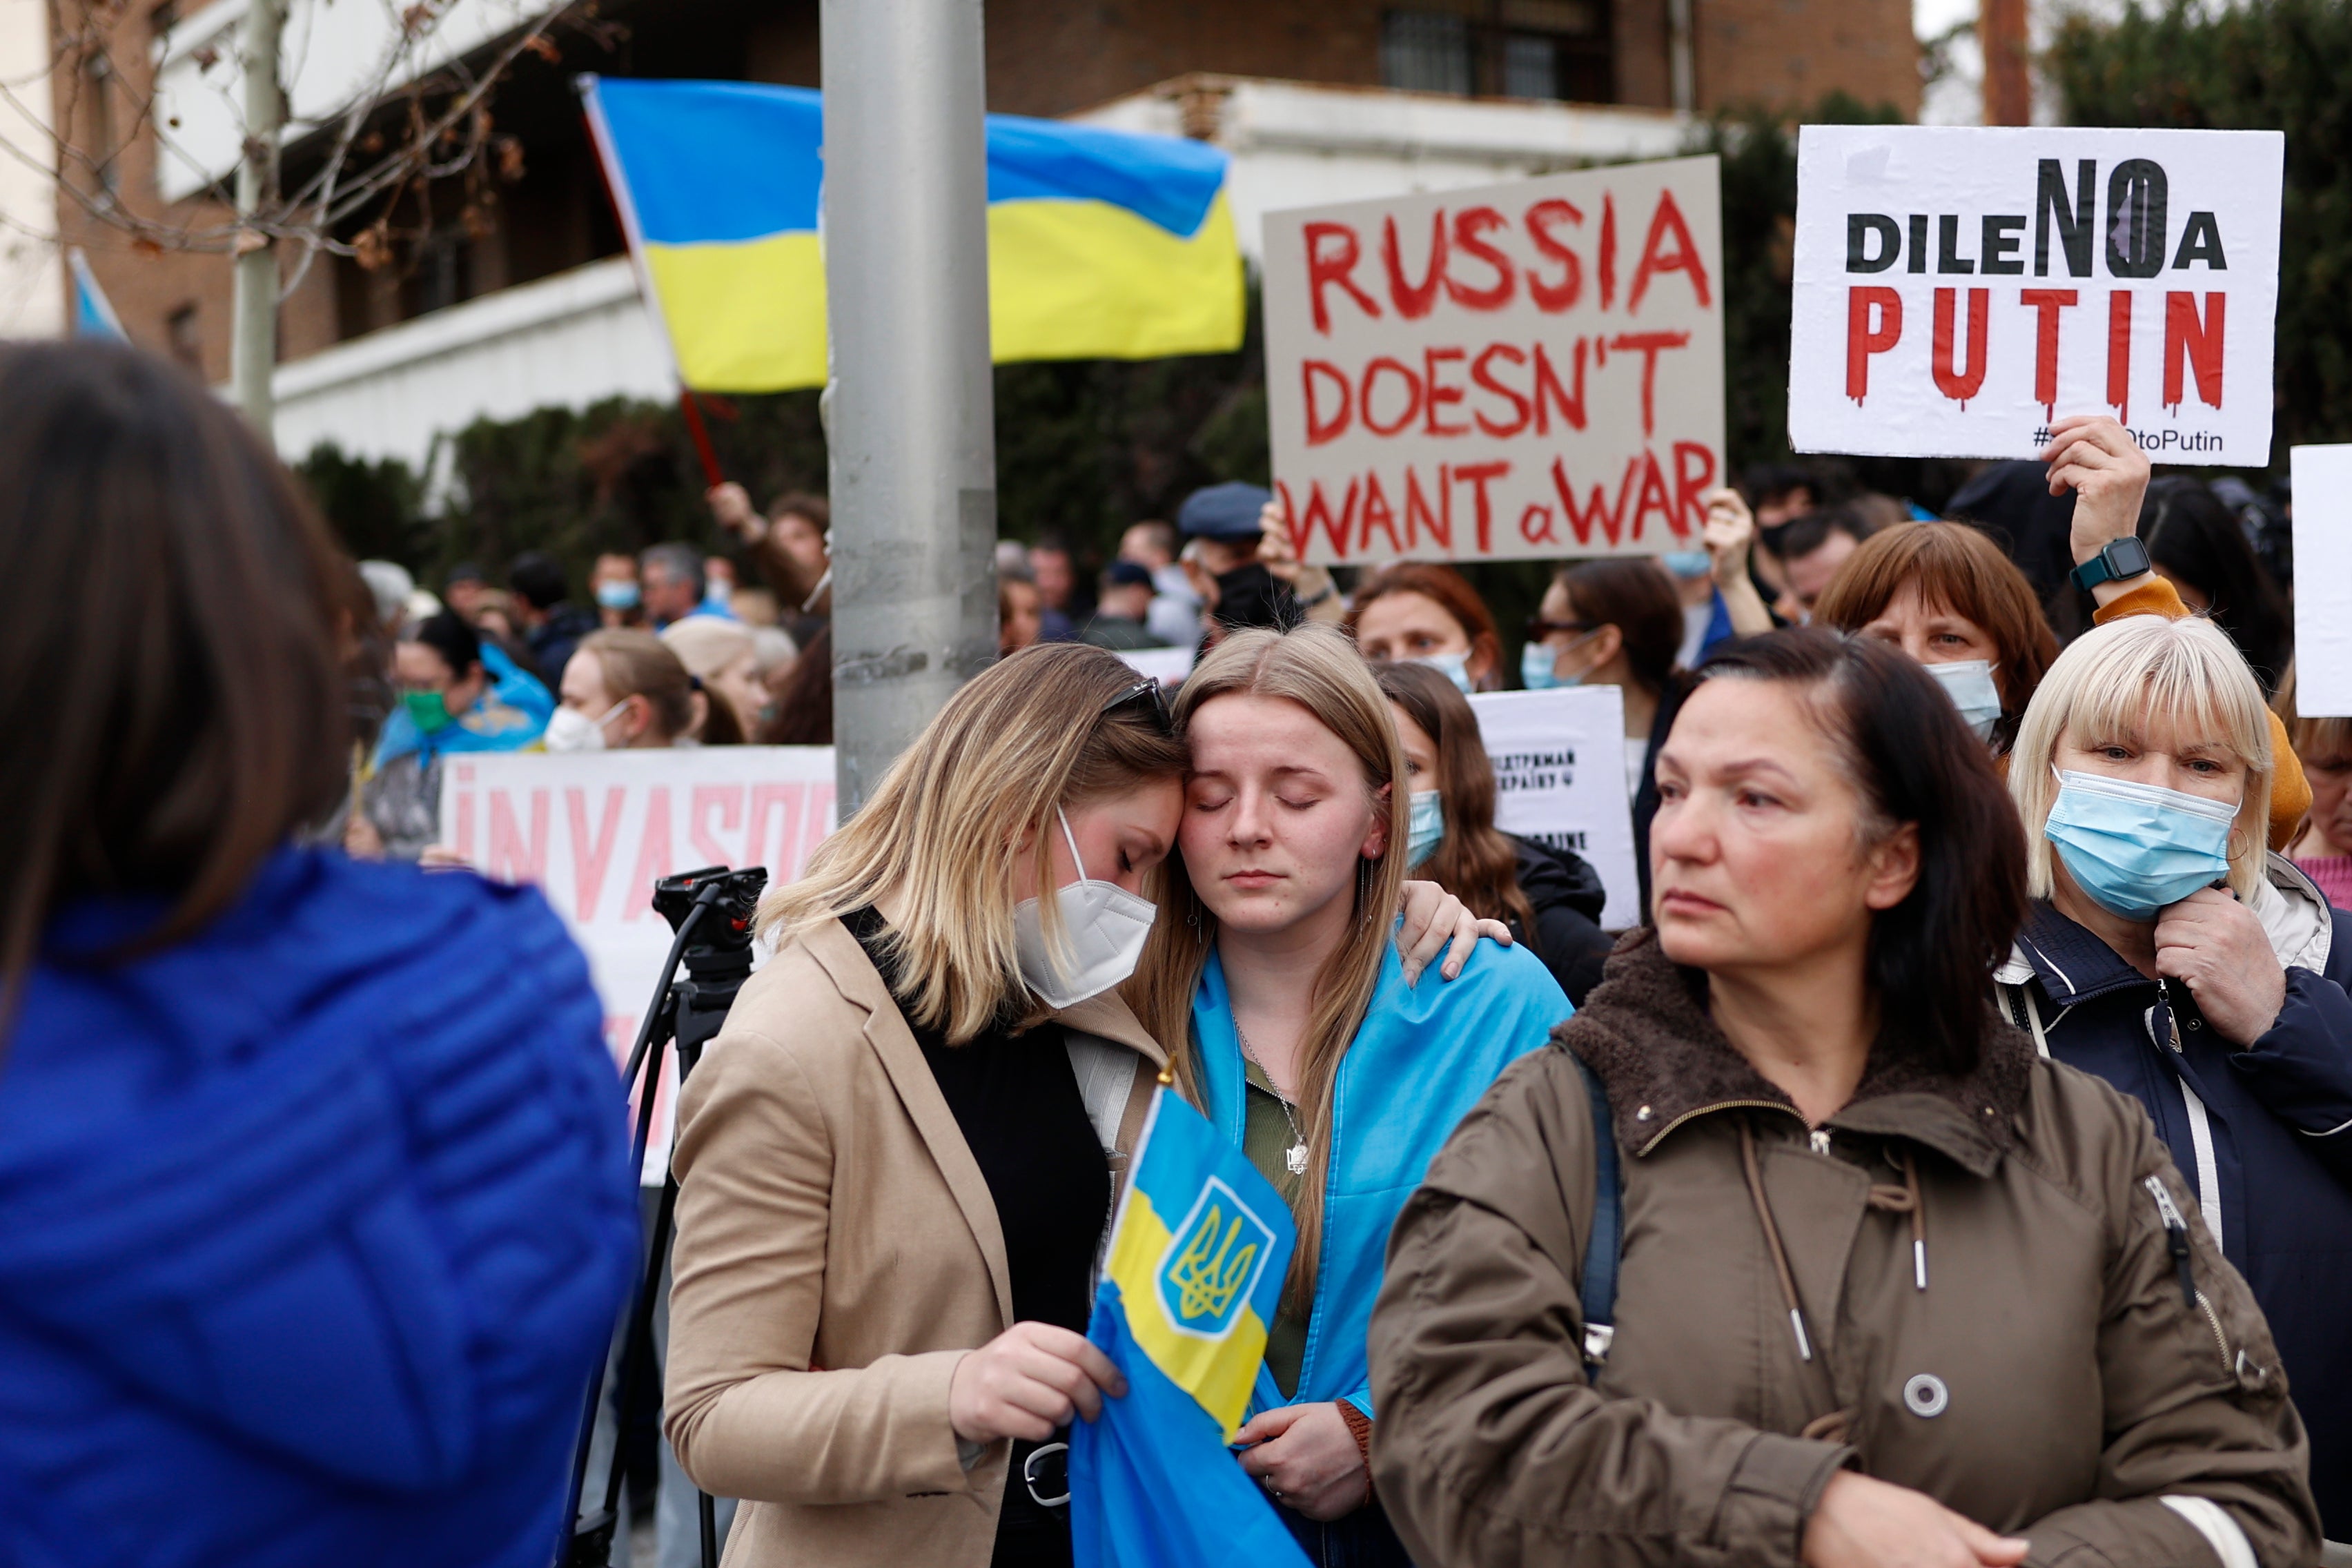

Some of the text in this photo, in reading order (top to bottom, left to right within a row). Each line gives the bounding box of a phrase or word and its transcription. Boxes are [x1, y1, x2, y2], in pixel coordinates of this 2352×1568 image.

[1302, 187, 1712, 337] RUSSIA
[1301, 330, 1691, 449] DOESN'T
[1845, 286, 2226, 421] PUTIN
[1273, 440, 1716, 562] WANT a WAR
